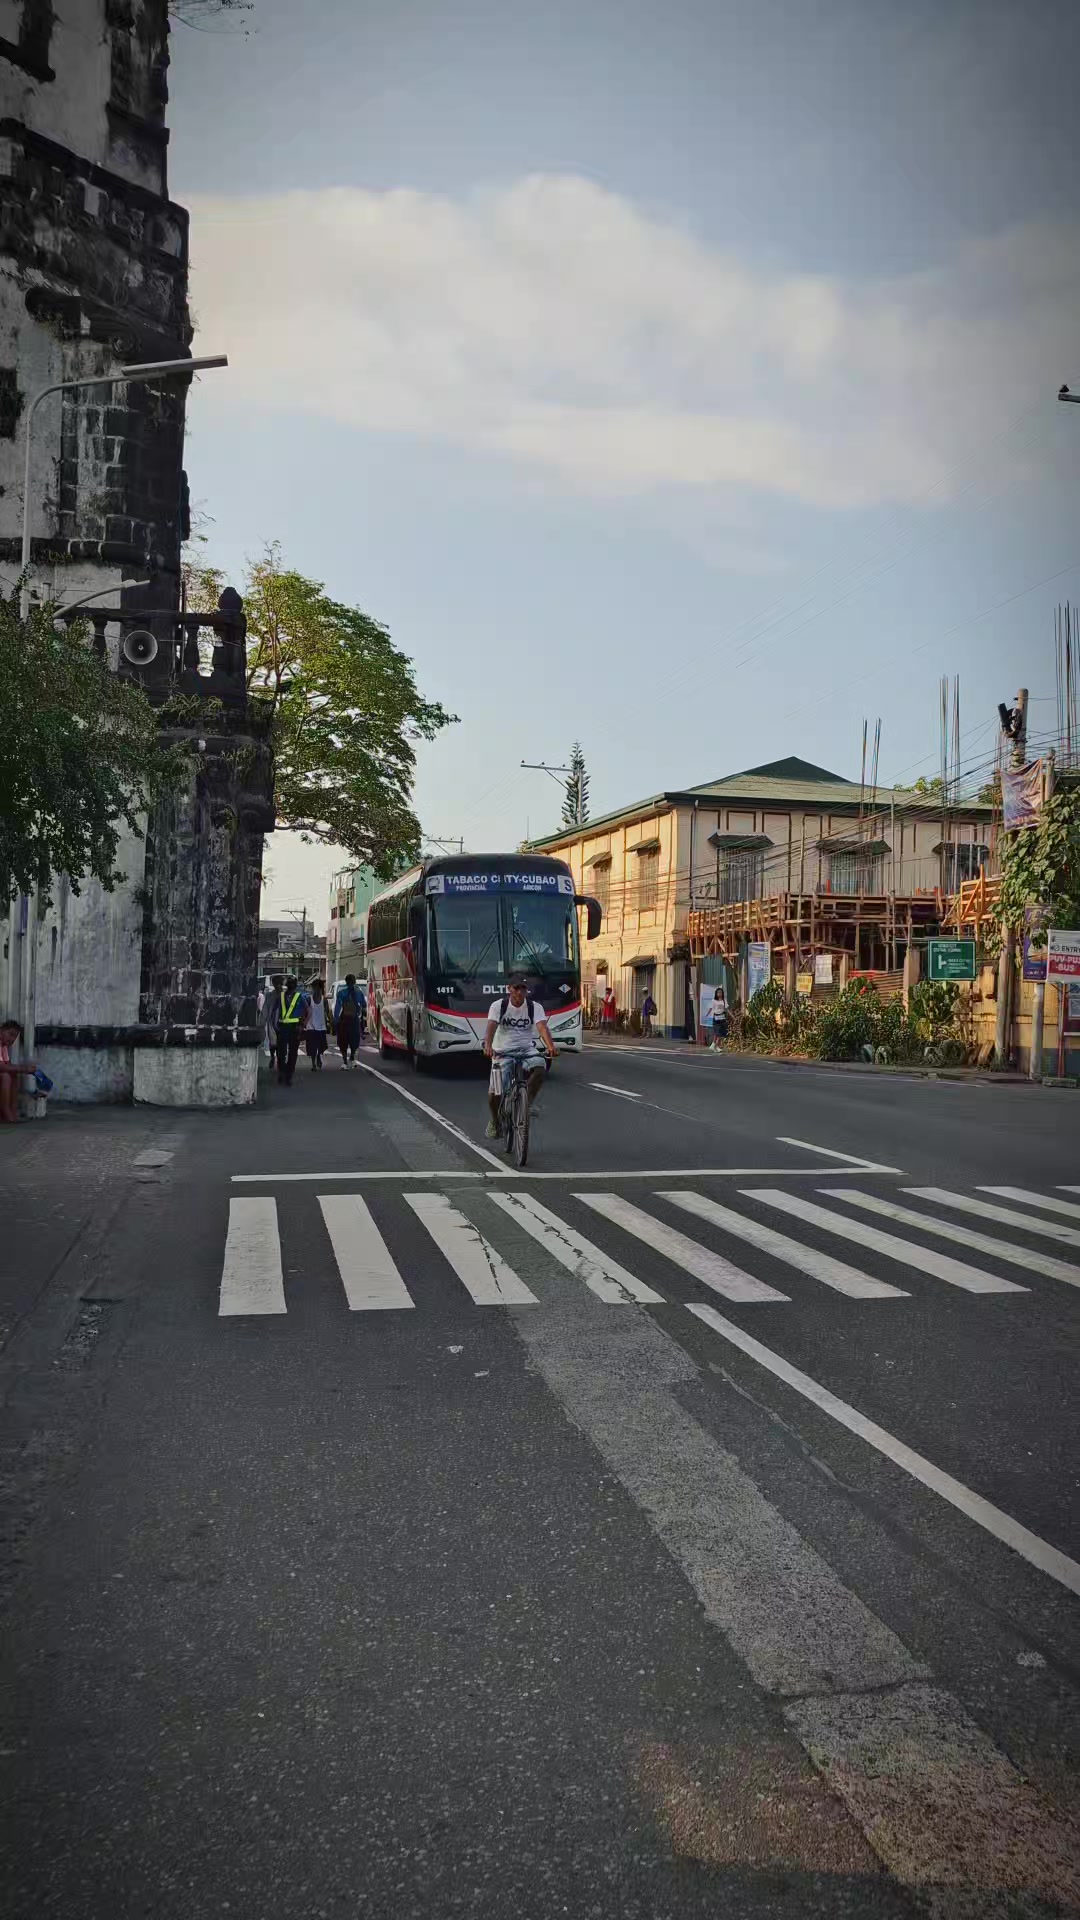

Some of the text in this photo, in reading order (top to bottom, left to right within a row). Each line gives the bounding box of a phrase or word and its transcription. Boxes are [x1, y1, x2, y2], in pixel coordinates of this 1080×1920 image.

[445, 875, 488, 885] TABACO
[564, 879, 573, 892] S
[455, 884, 487, 892] PROVINCIAL
[436, 986, 455, 994] 1411
[502, 1018, 530, 1028] NGCP
